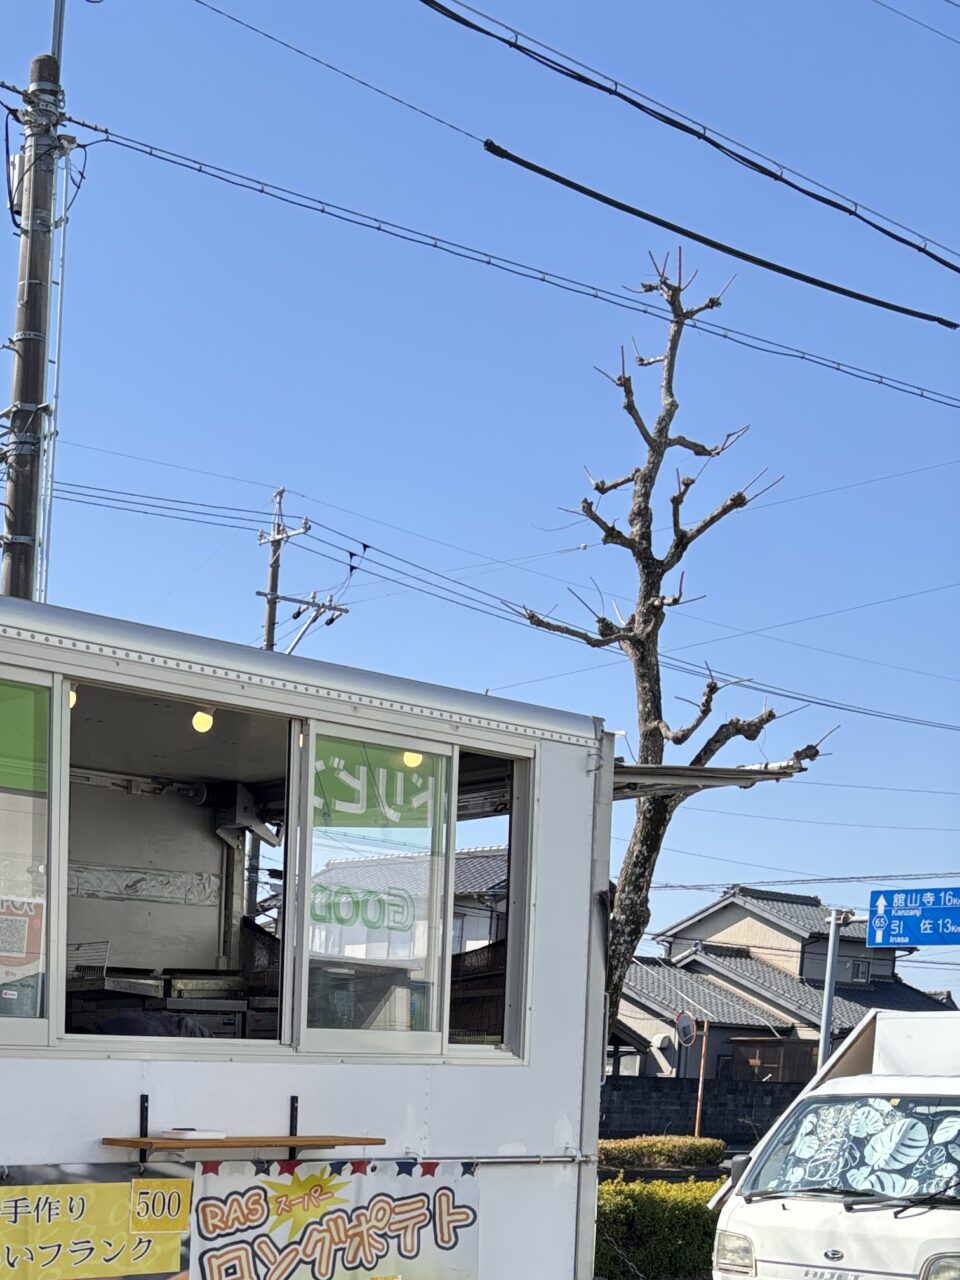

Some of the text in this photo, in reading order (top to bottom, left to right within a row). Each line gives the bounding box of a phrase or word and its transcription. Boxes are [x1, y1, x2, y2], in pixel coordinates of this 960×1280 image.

[875, 918, 885, 927] 65
[892, 908, 921, 917] Kanzanji
[136, 1190, 181, 1218] 500
[200, 1188, 267, 1238] RAS
[276, 1186, 334, 1215] スーパー
